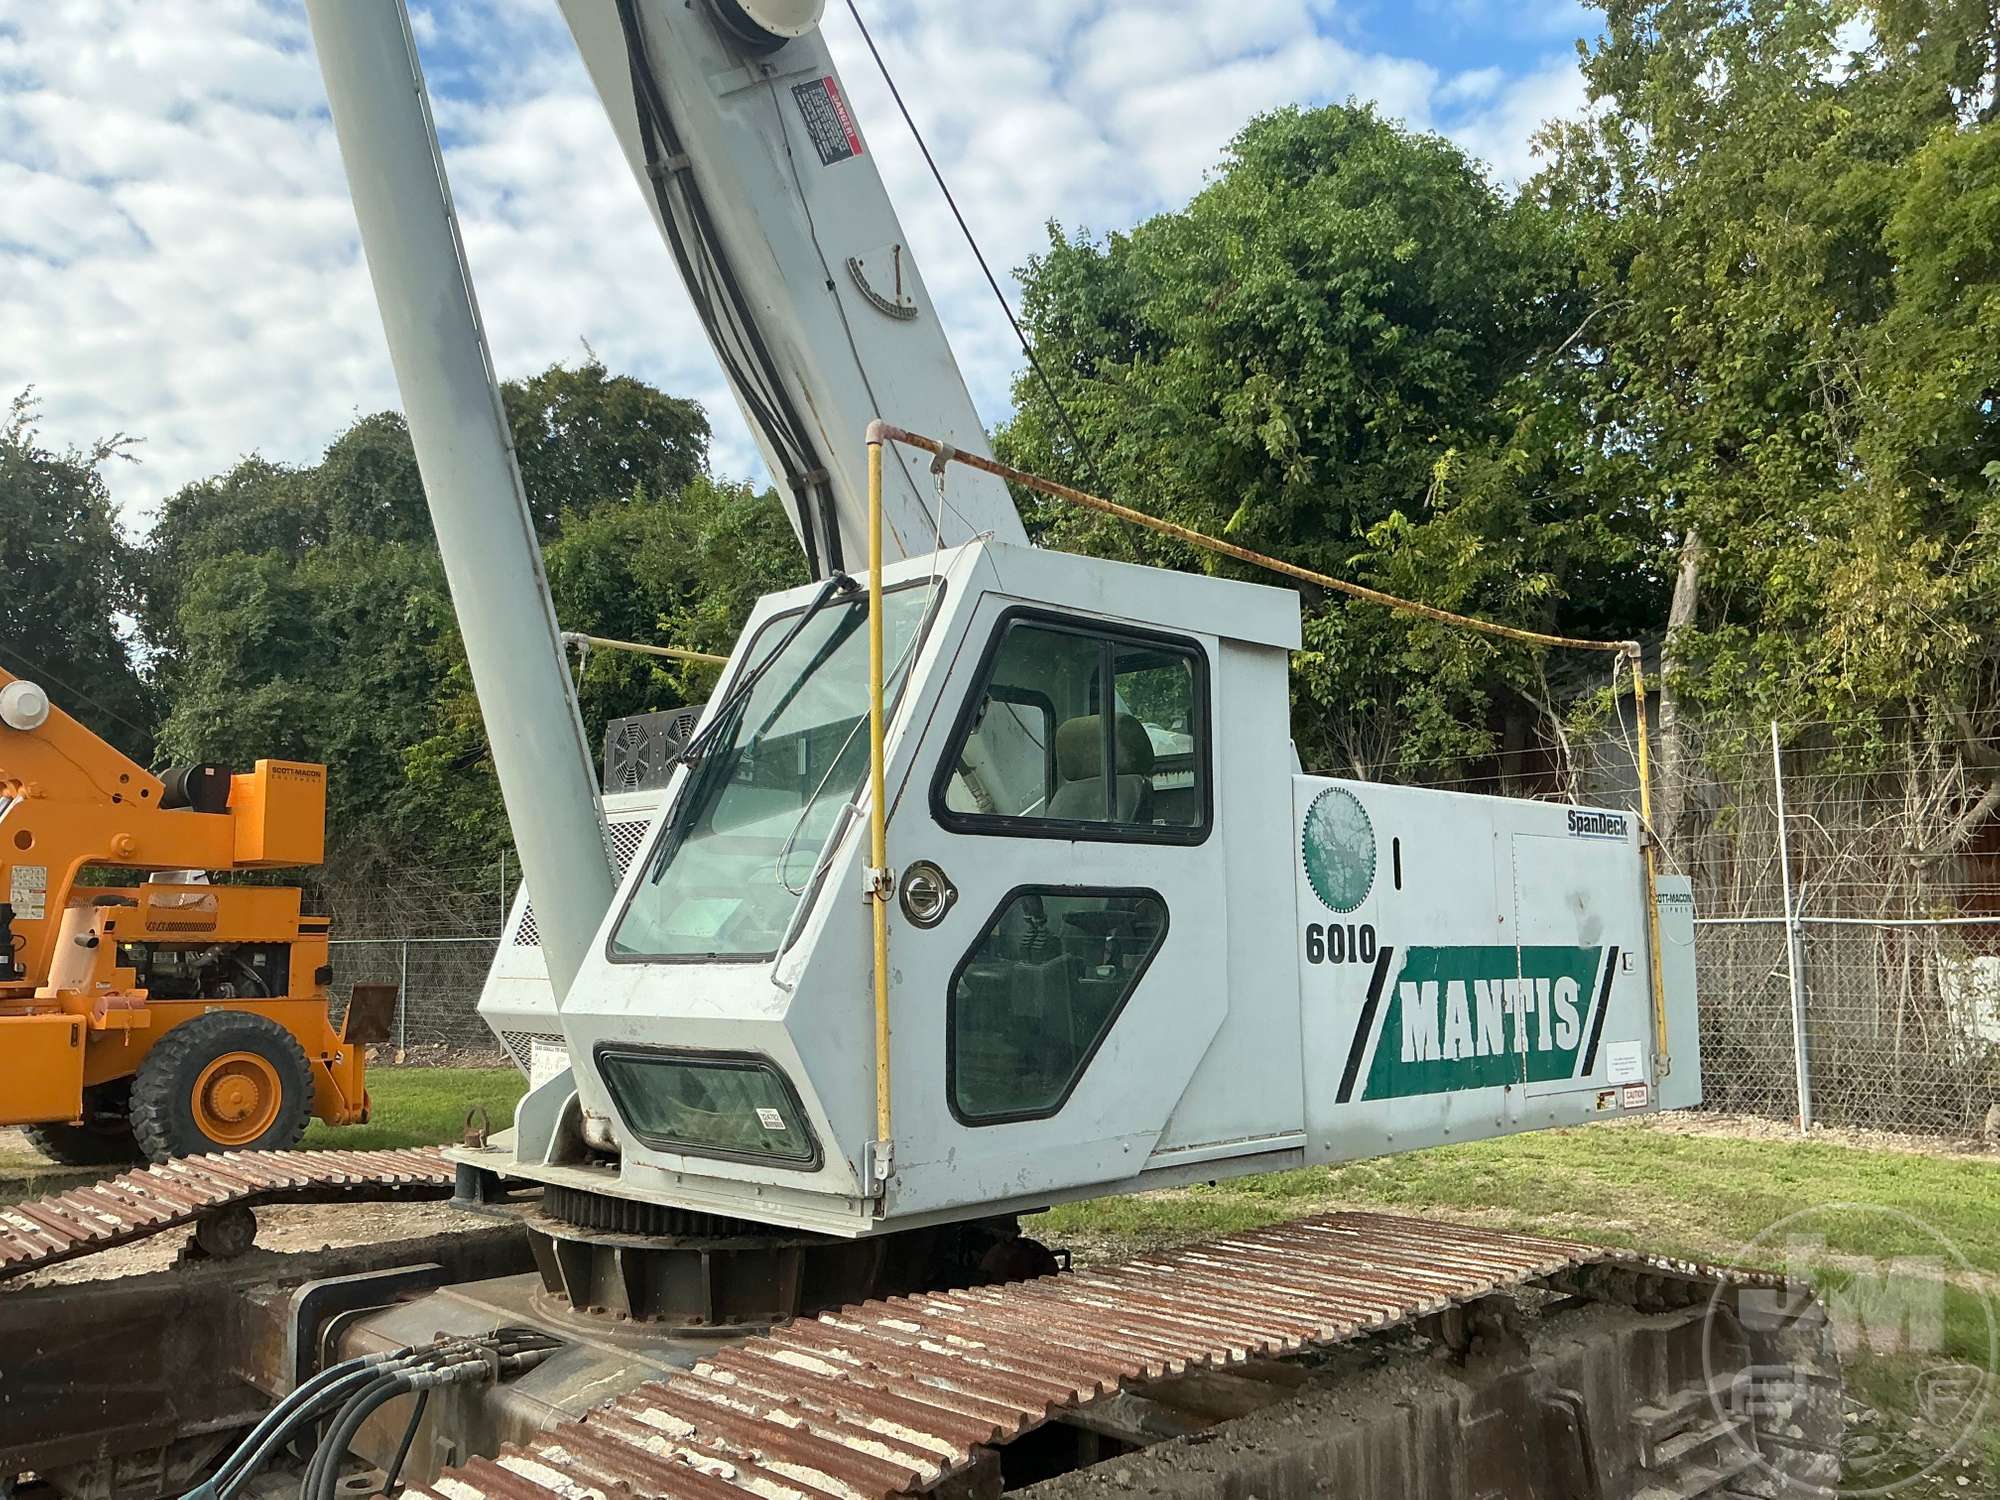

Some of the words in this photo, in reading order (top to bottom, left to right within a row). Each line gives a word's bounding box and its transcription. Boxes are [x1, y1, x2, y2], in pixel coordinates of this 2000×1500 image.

[1568, 809, 1628, 837] SpanDeck
[1655, 893, 1692, 903] OTT-MACON
[1306, 923, 1376, 964] 6010
[1400, 976, 1581, 1063] MANTIS
